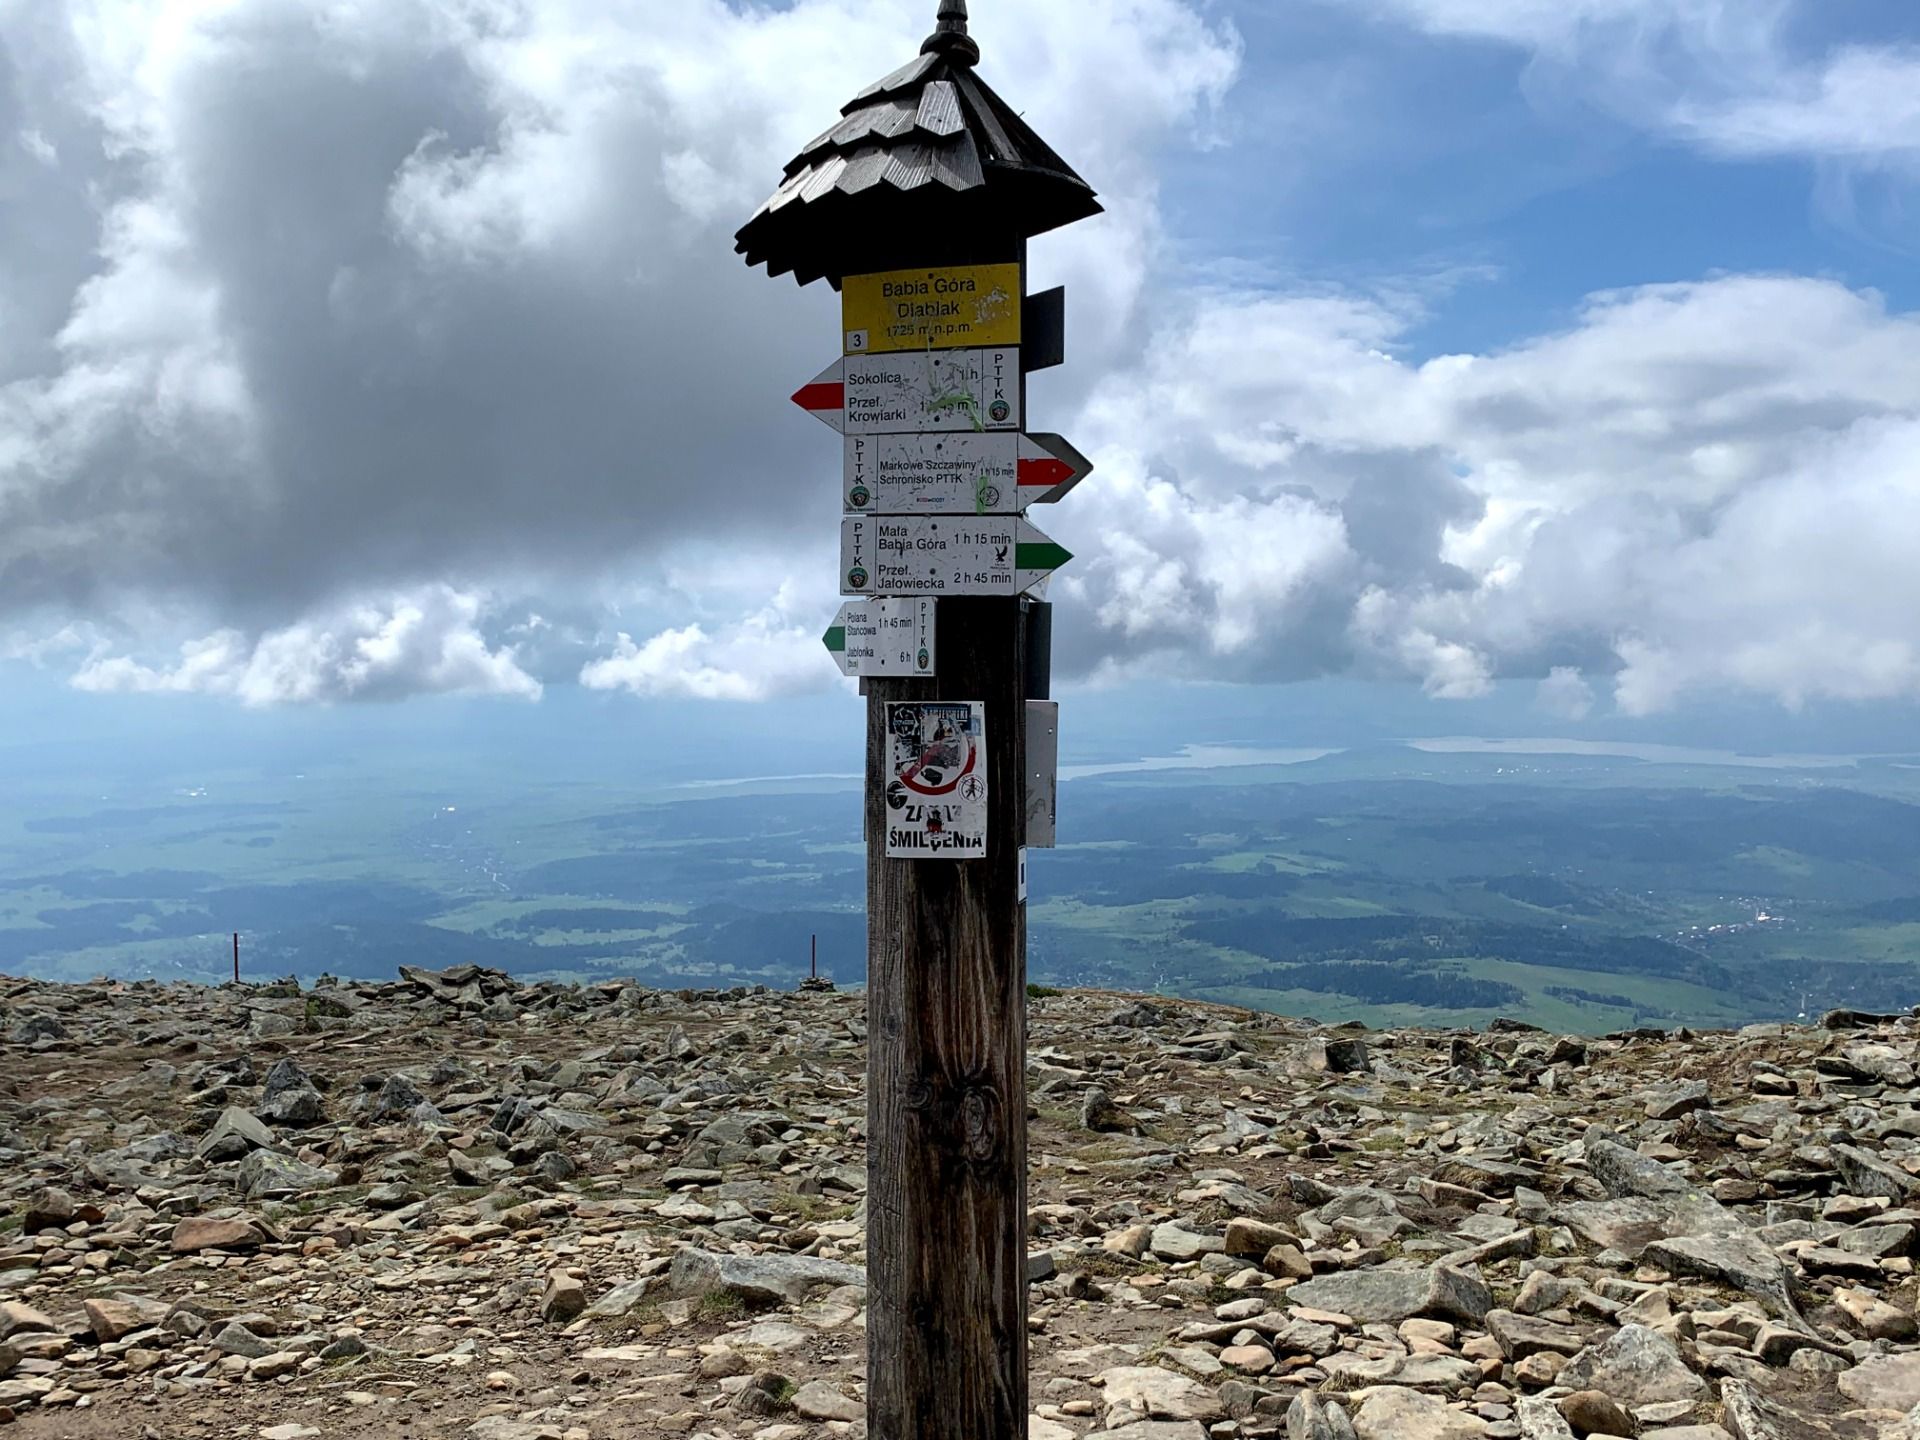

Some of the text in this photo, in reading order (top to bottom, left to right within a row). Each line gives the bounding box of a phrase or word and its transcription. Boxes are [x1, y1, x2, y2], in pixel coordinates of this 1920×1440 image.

[883, 277, 976, 297] Babia Góra
[898, 301, 960, 318] Diablak
[886, 325, 914, 337] 1725
[935, 323, 973, 335] n.p.m.
[853, 335, 862, 347] 3
[849, 372, 901, 385] Sokolica
[971, 369, 977, 379] h
[849, 397, 883, 408] Przeł.
[958, 401, 978, 410] mn
[849, 409, 906, 422] Krowiarki
[880, 459, 976, 471] Markowe Szczawiny
[992, 467, 999, 475] 15
[1001, 467, 1014, 475] min
[880, 474, 962, 485] Schronisko PTTK
[879, 525, 908, 537] Mała
[955, 533, 1011, 544] 1 h 15 min
[879, 539, 946, 550] Babia Góra
[878, 565, 911, 576] Przeł.
[878, 577, 945, 589] Jałowiecka
[954, 572, 1011, 583] 2 h 45 min
[847, 613, 867, 622] Polana
[879, 618, 912, 628] 1 h 45 min
[847, 647, 874, 657] Jabłonka
[900, 651, 910, 662] 6 h
